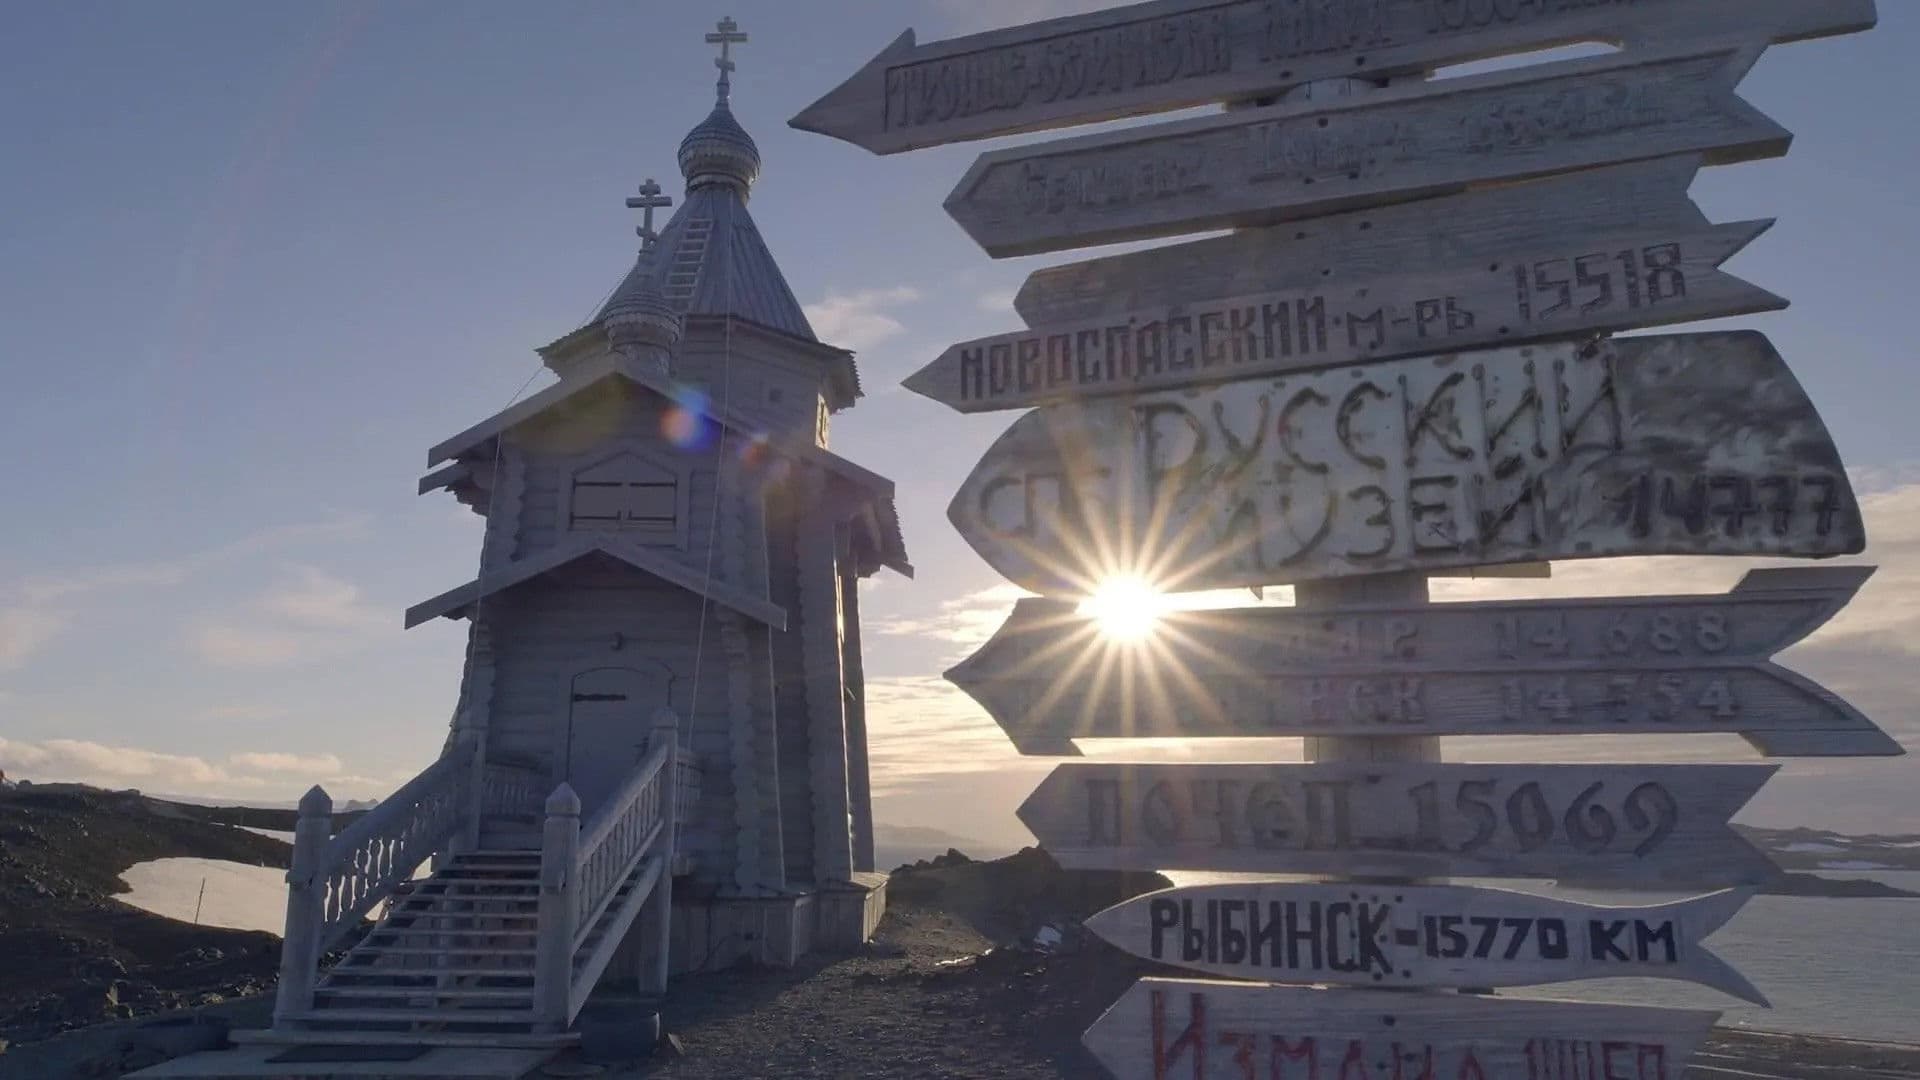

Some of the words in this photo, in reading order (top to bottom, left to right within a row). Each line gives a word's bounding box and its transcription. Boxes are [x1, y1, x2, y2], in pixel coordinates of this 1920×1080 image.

[1514, 242, 1687, 322] 15518
[1616, 472, 1843, 539] 14777
[1407, 780, 1678, 860] 15069
[1588, 918, 1678, 963] КМ
